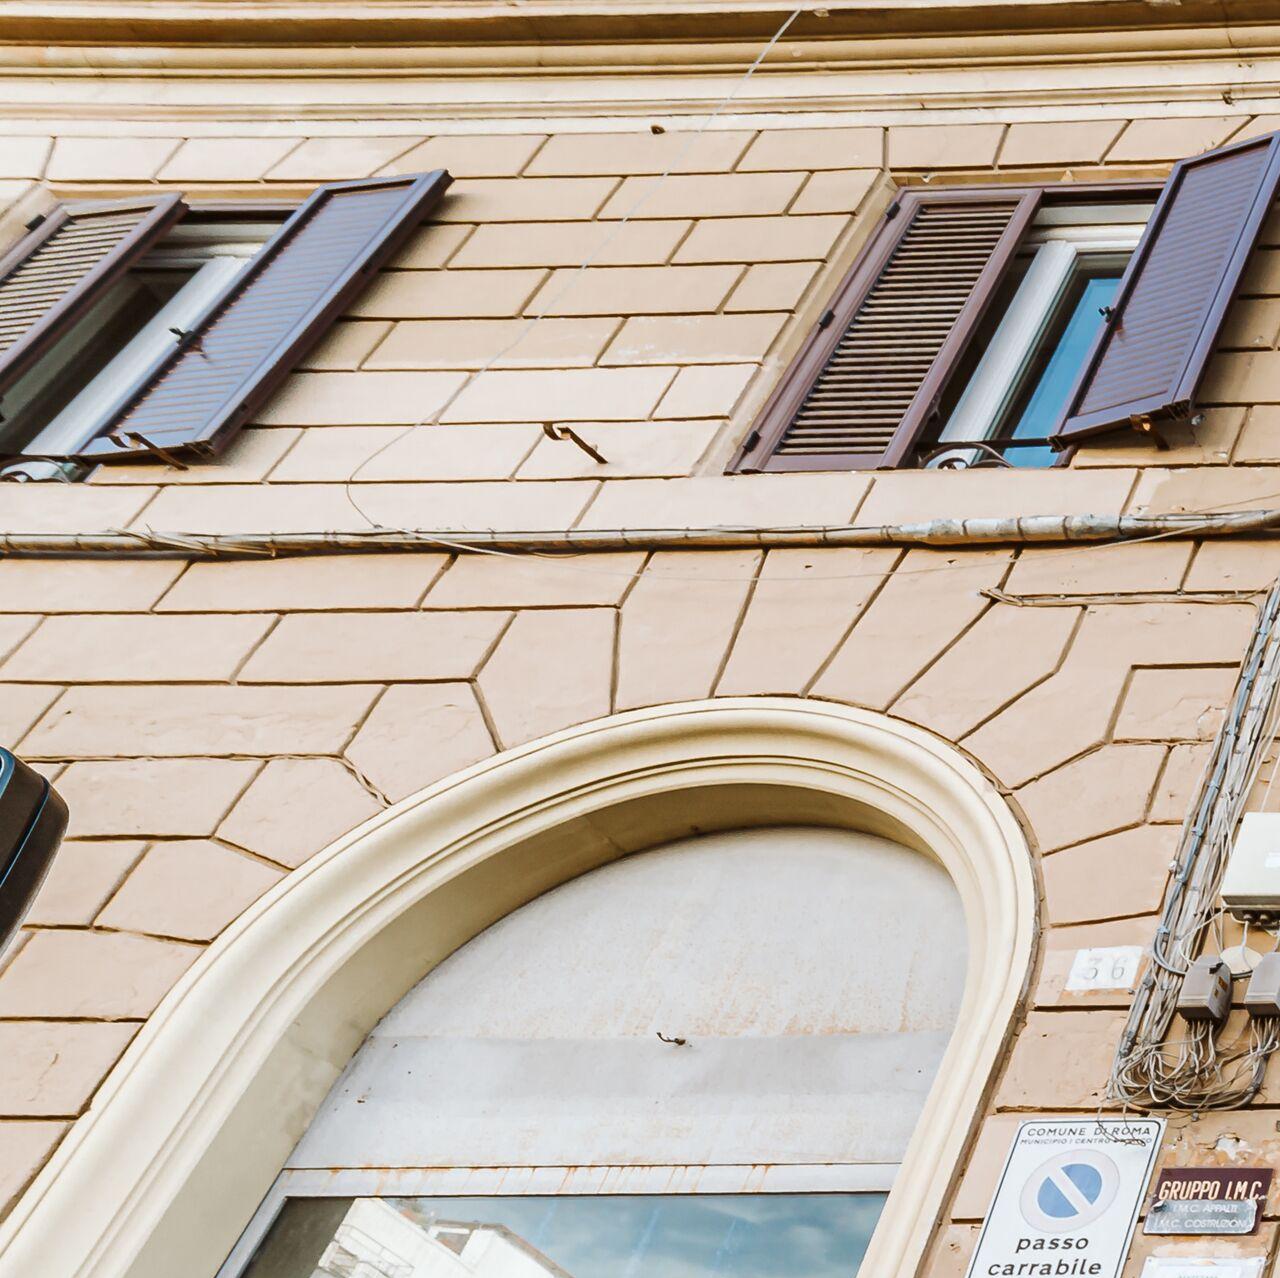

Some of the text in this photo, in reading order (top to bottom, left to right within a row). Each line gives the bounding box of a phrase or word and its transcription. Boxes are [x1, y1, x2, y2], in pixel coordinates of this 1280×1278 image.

[1082, 957, 1128, 980] 36
[1027, 1127, 1086, 1137] COMUNE
[1111, 1127, 1150, 1136] ROMA
[1074, 1137, 1110, 1145] CENTRO
[1158, 1180, 1221, 1200] GRUPPO
[1015, 1236, 1089, 1254] passo
[987, 1258, 1102, 1276] carrabile
